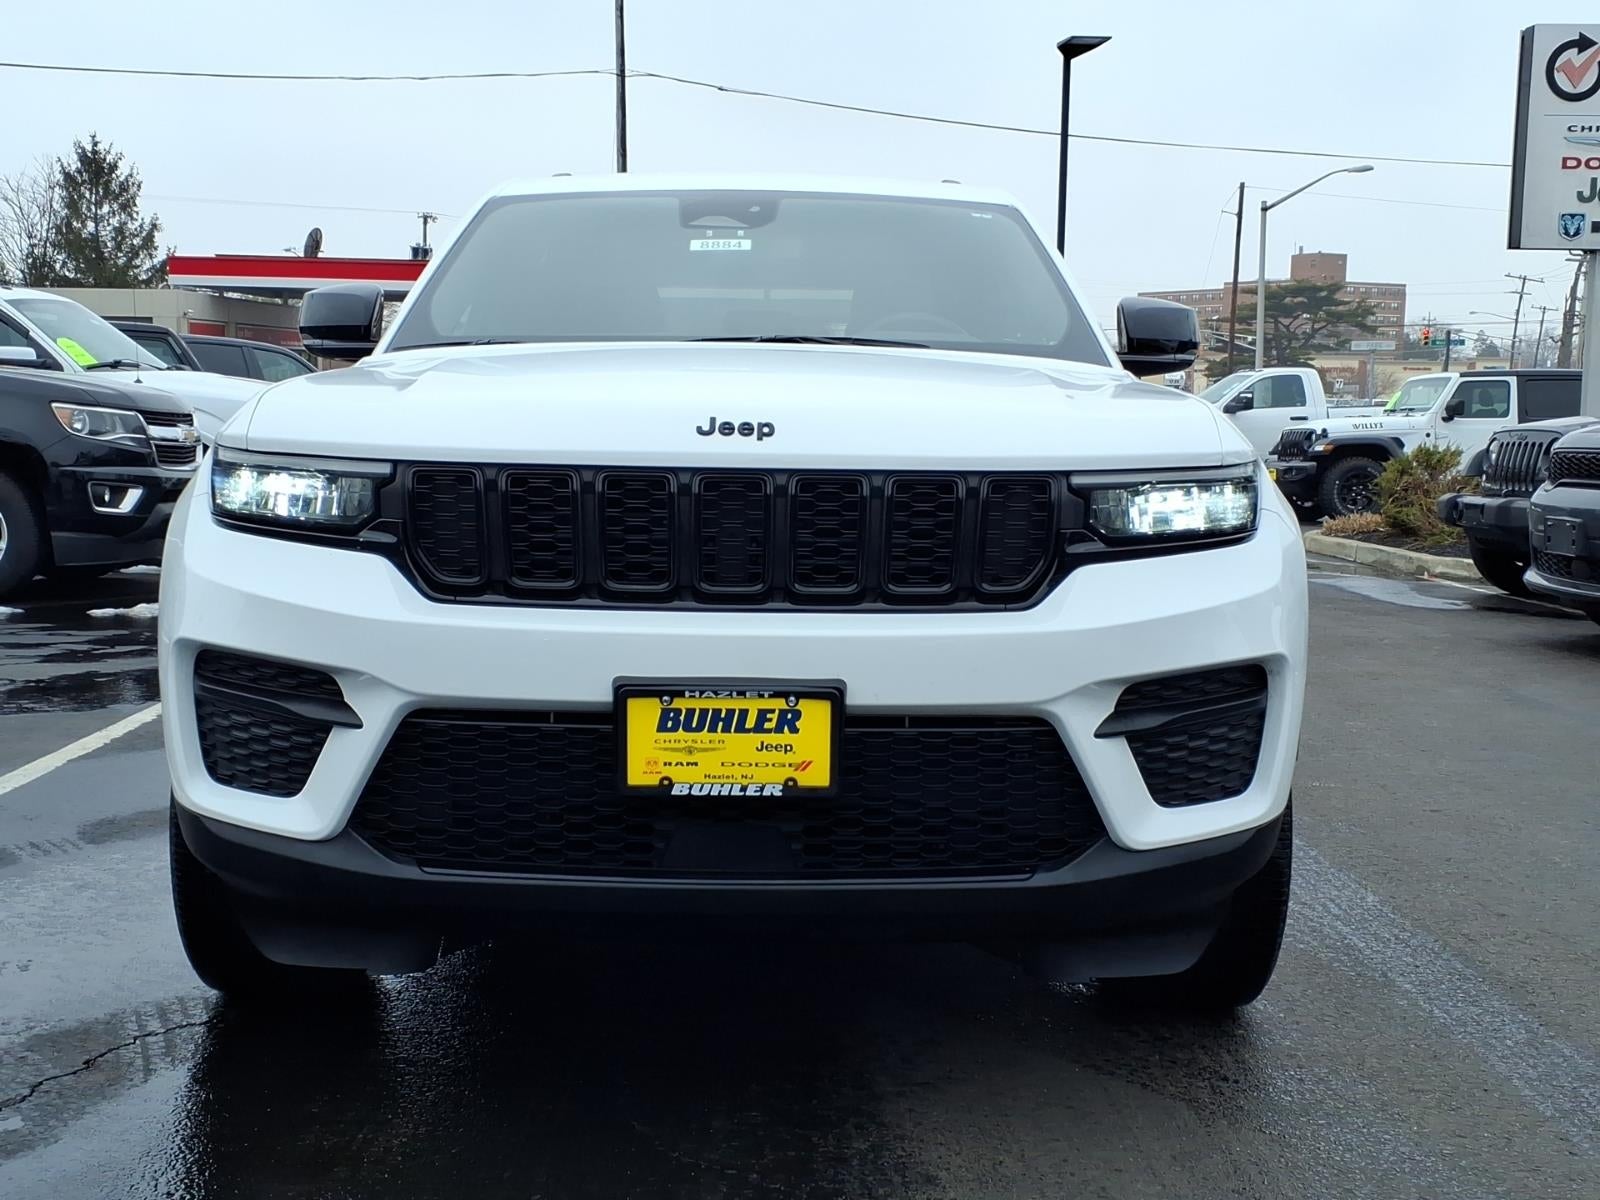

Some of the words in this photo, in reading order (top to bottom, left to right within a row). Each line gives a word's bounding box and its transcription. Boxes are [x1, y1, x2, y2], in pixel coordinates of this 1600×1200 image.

[1567, 124, 1600, 133] CH
[1576, 177, 1600, 204] J
[700, 241, 742, 249] 8884
[696, 416, 775, 442] Jeep
[1352, 422, 1384, 430] WILLYS
[684, 690, 773, 699] HAZLET
[655, 707, 803, 734] BUHLER
[755, 741, 793, 755] Jeep
[671, 783, 784, 796] BUHLER
